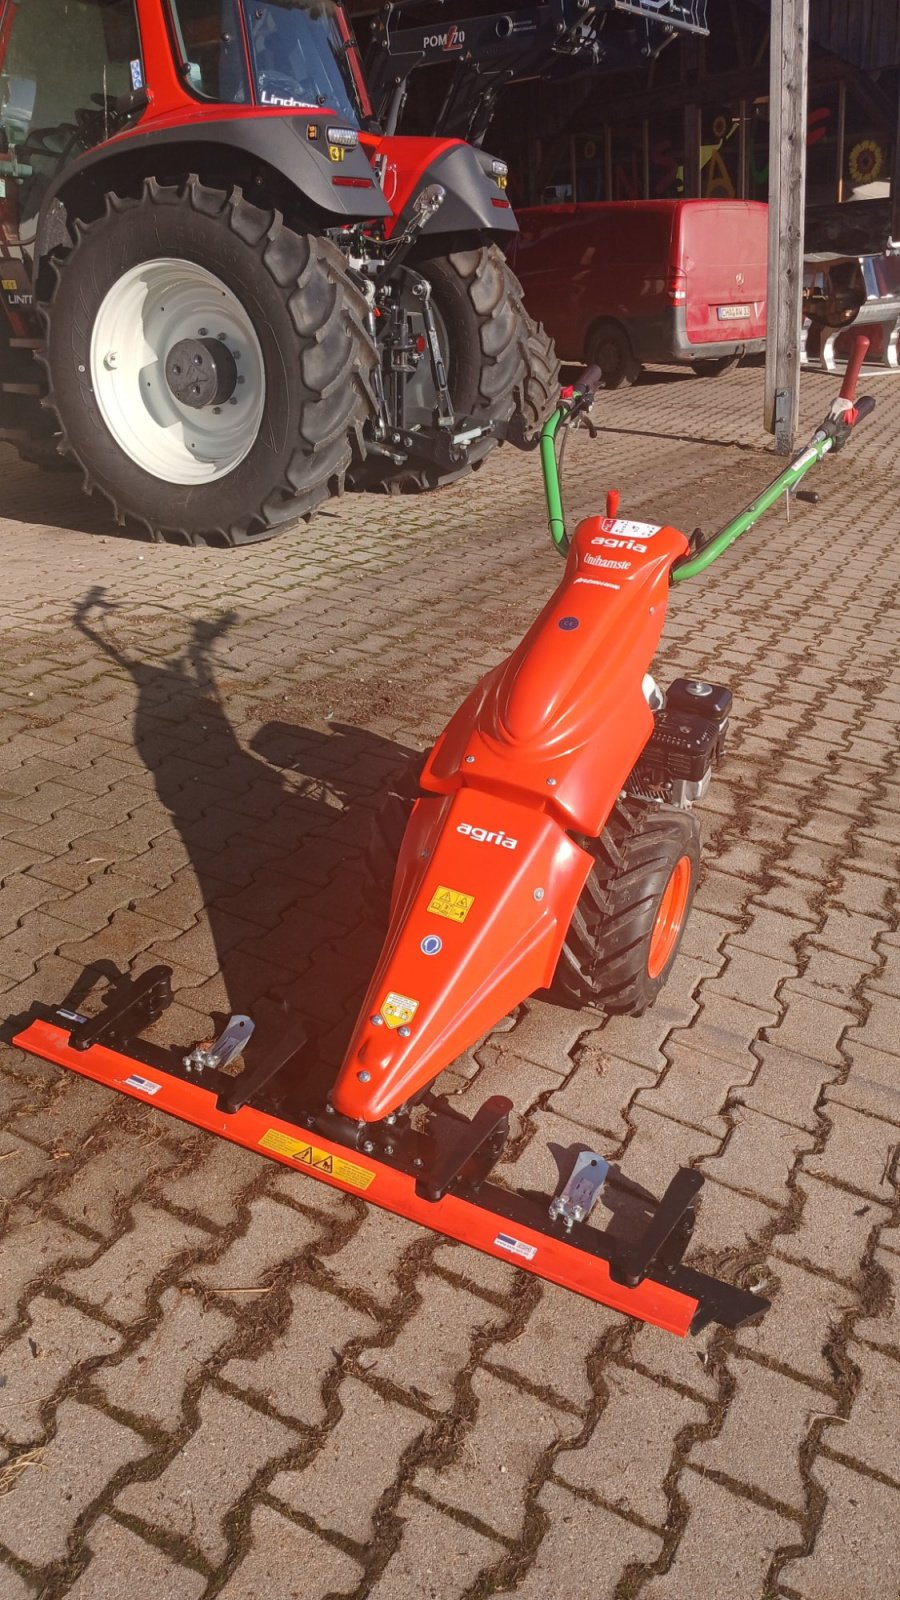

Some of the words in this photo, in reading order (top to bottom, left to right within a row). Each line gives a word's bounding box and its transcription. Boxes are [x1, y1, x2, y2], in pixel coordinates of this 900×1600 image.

[260, 90, 320, 109] Lindn
[591, 536, 648, 553] agria
[456, 822, 518, 850] agria
